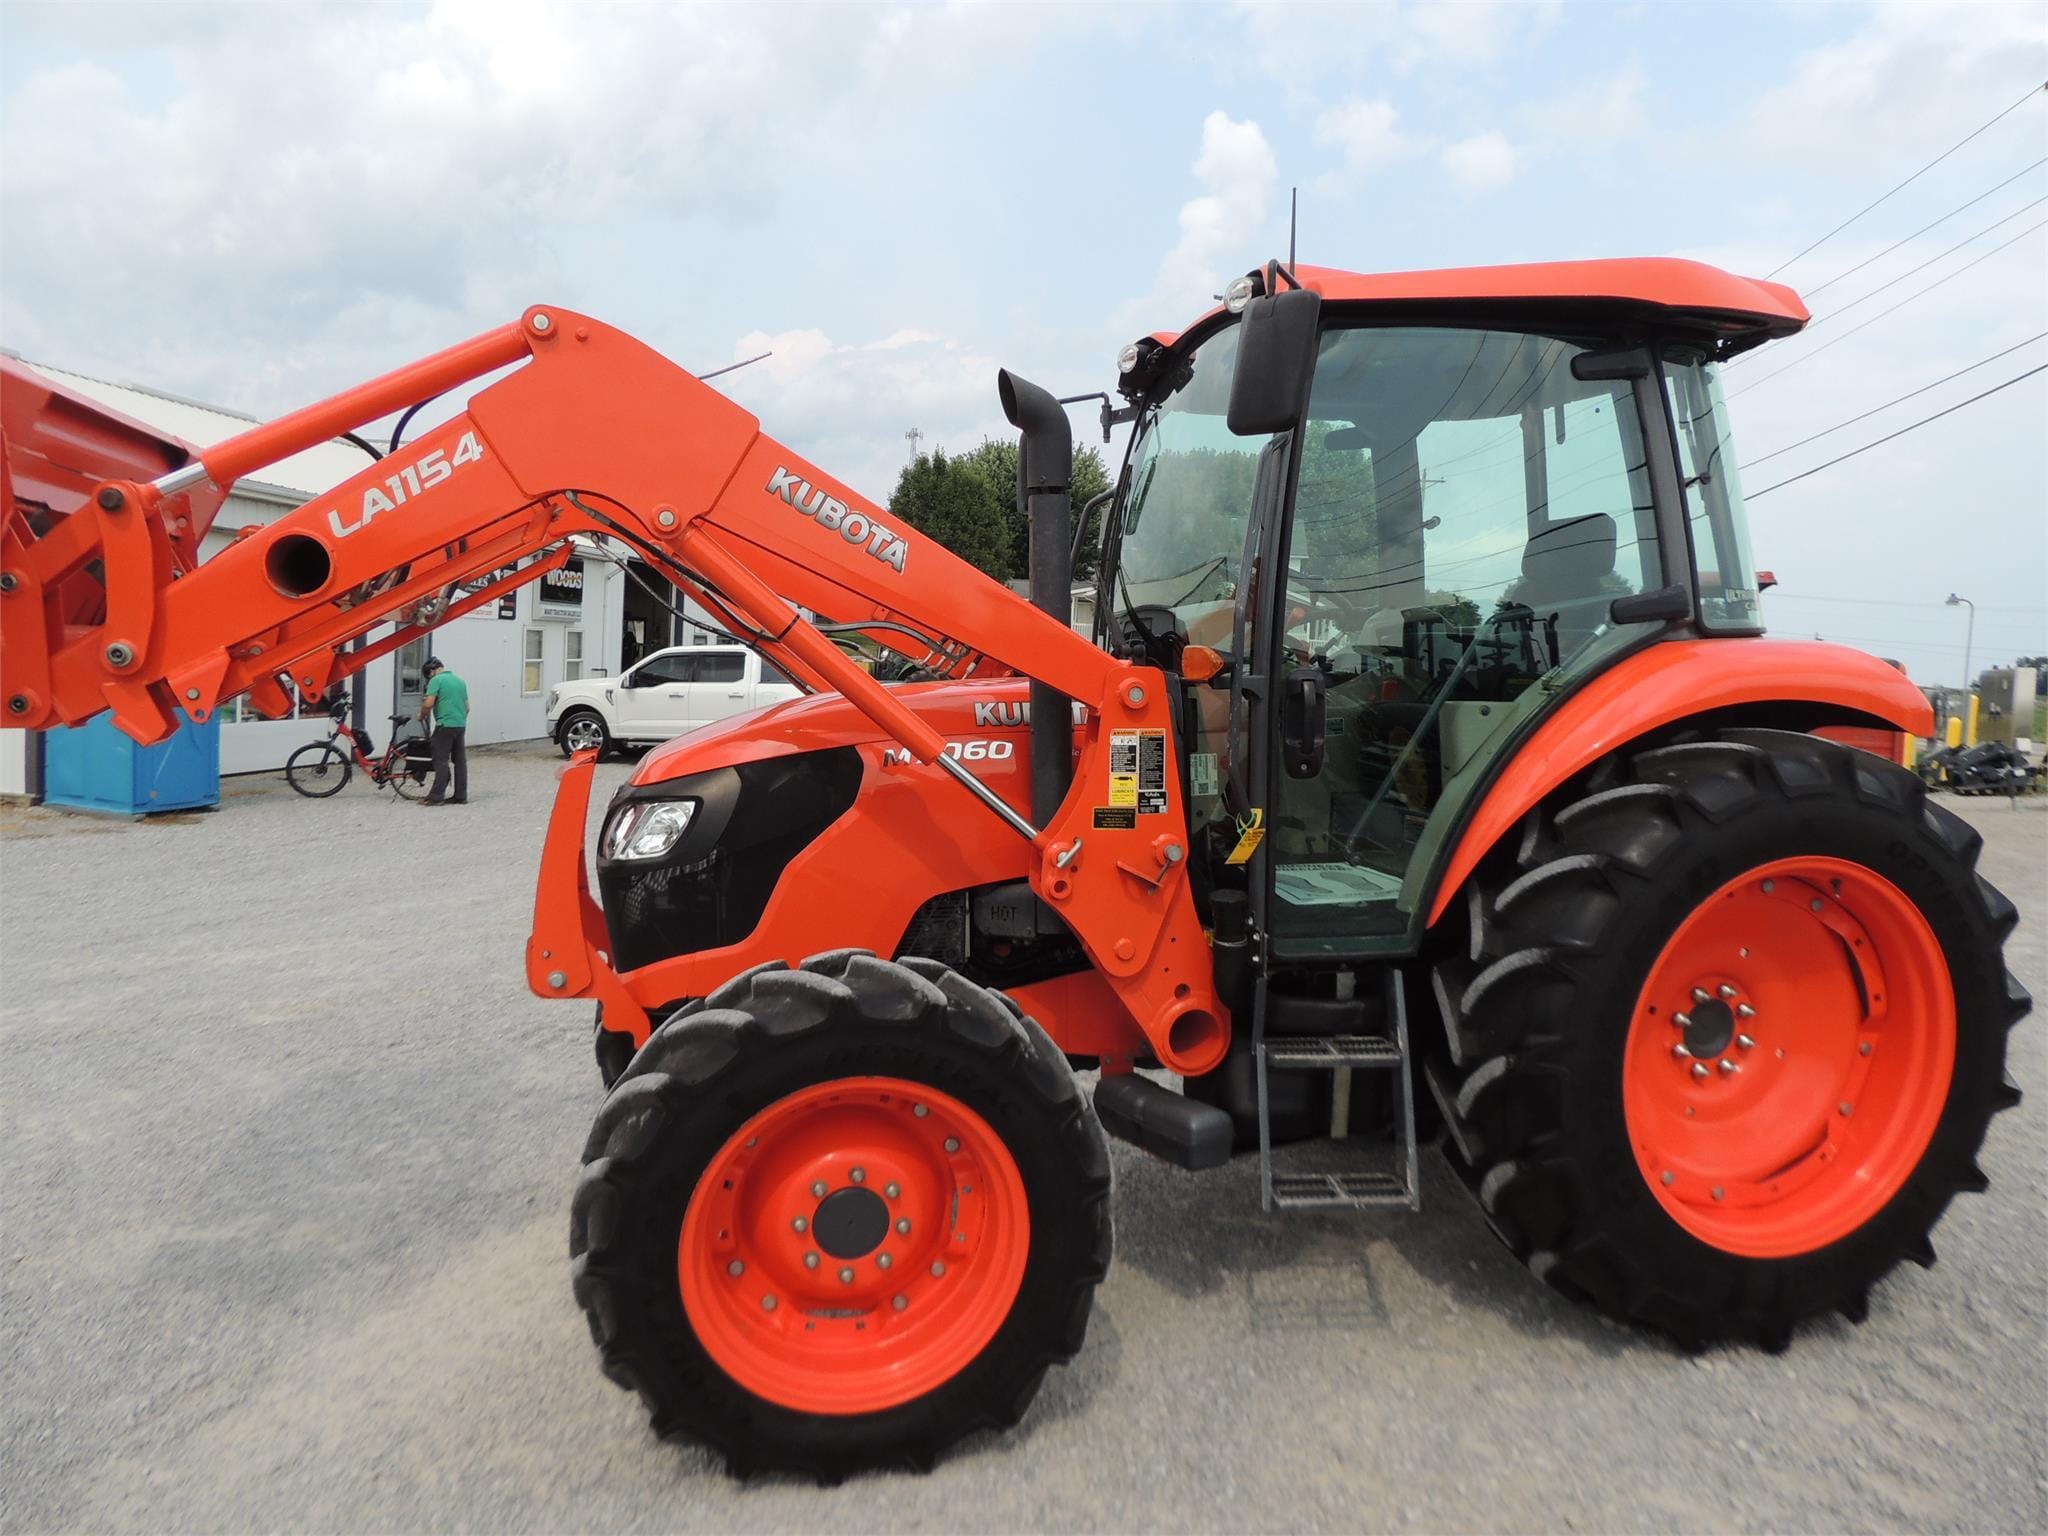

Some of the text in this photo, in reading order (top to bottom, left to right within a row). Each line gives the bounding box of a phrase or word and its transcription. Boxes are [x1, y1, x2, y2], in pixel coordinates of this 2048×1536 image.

[327, 431, 484, 538] LA1154
[765, 465, 908, 575] KUBOTA
[547, 569, 583, 589] WOODS
